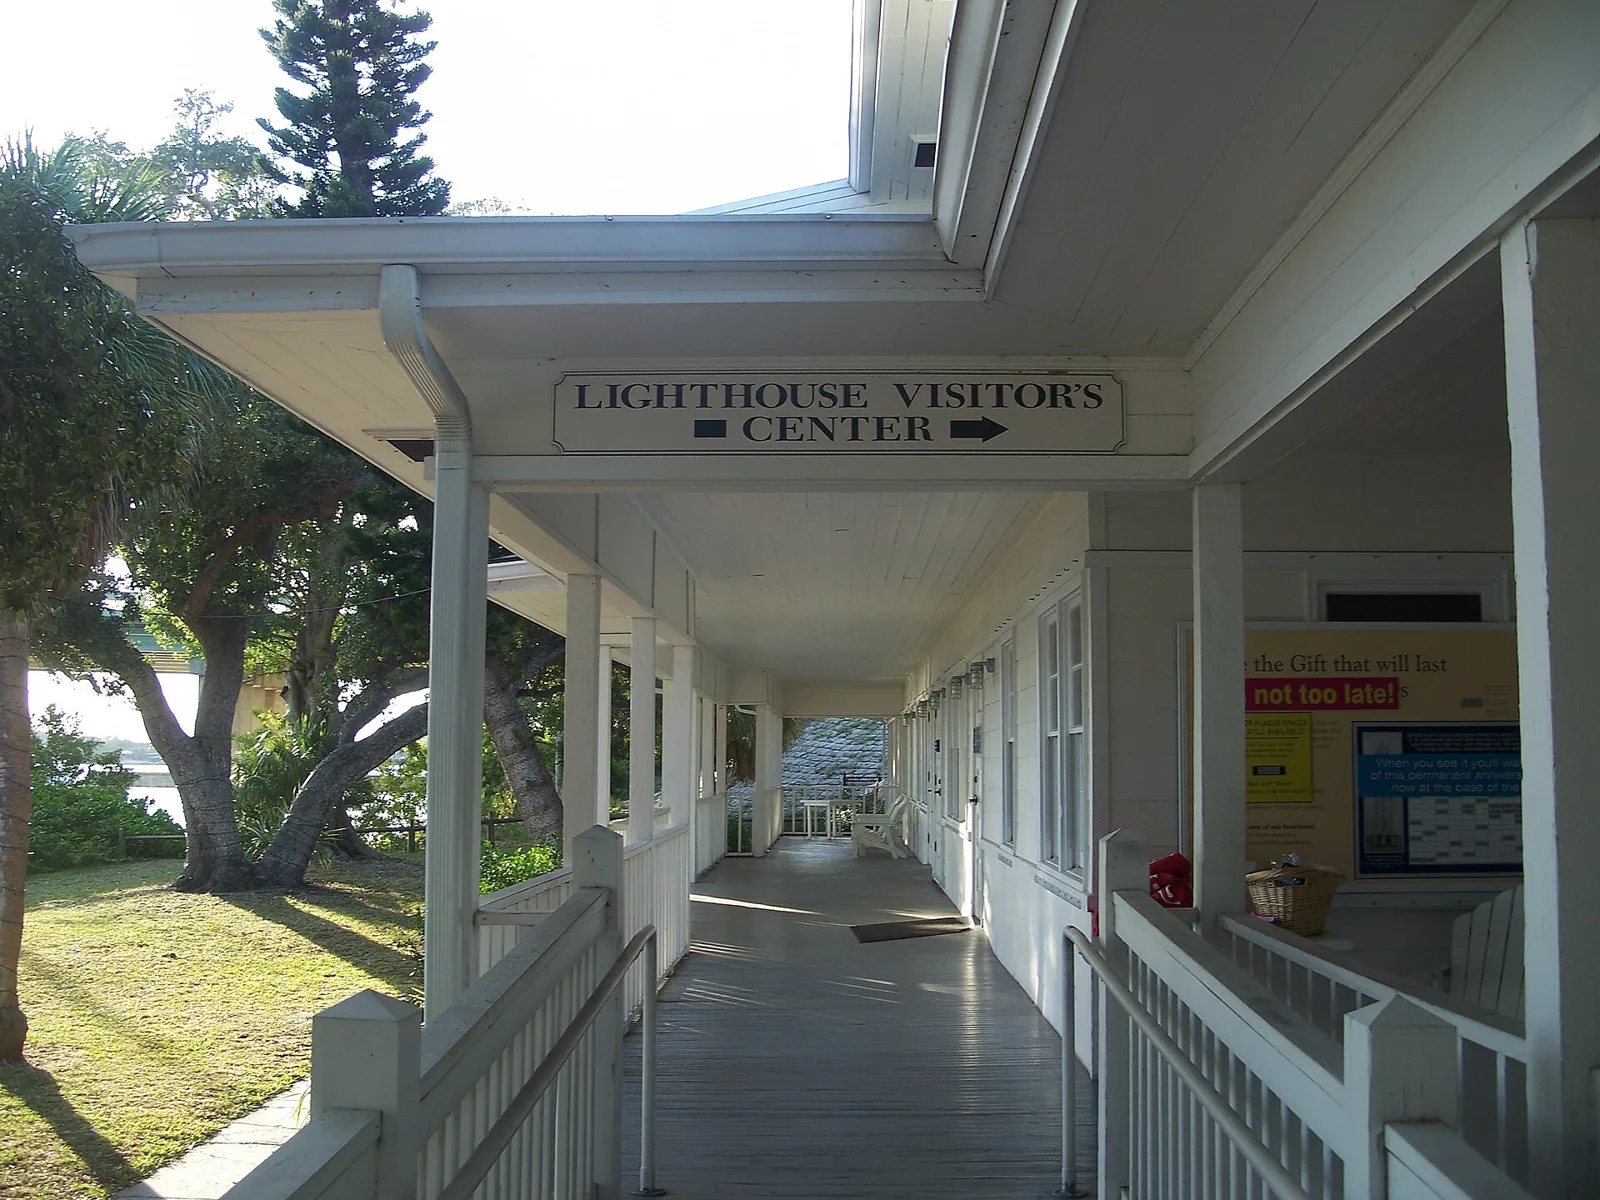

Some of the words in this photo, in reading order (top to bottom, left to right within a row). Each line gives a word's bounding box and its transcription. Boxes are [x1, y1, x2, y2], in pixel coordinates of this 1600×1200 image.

[573, 382, 868, 410] LIGHTHOUSE
[896, 382, 1103, 410] VISITOR'S
[742, 415, 934, 442] CENTER
[1254, 654, 1284, 673] the
[1290, 654, 1328, 673] Gift
[1333, 654, 1371, 673] that
[1376, 654, 1410, 673] will
[1416, 654, 1448, 673] last
[1254, 684, 1293, 705] not
[1298, 684, 1337, 705] too
[1344, 682, 1394, 705] late!
[1375, 758, 1409, 768] When
[1413, 760, 1434, 770] you
[1436, 760, 1457, 768] see
[1460, 758, 1468, 768] it
[1369, 771, 1381, 780] of
[1384, 771, 1405, 780] this
[1408, 771, 1471, 782] permanent
[1391, 784, 1416, 792] now
[1419, 783, 1430, 792] at
[1433, 782, 1451, 792] the
[1455, 782, 1483, 792] base
[1487, 782, 1498, 792] of
